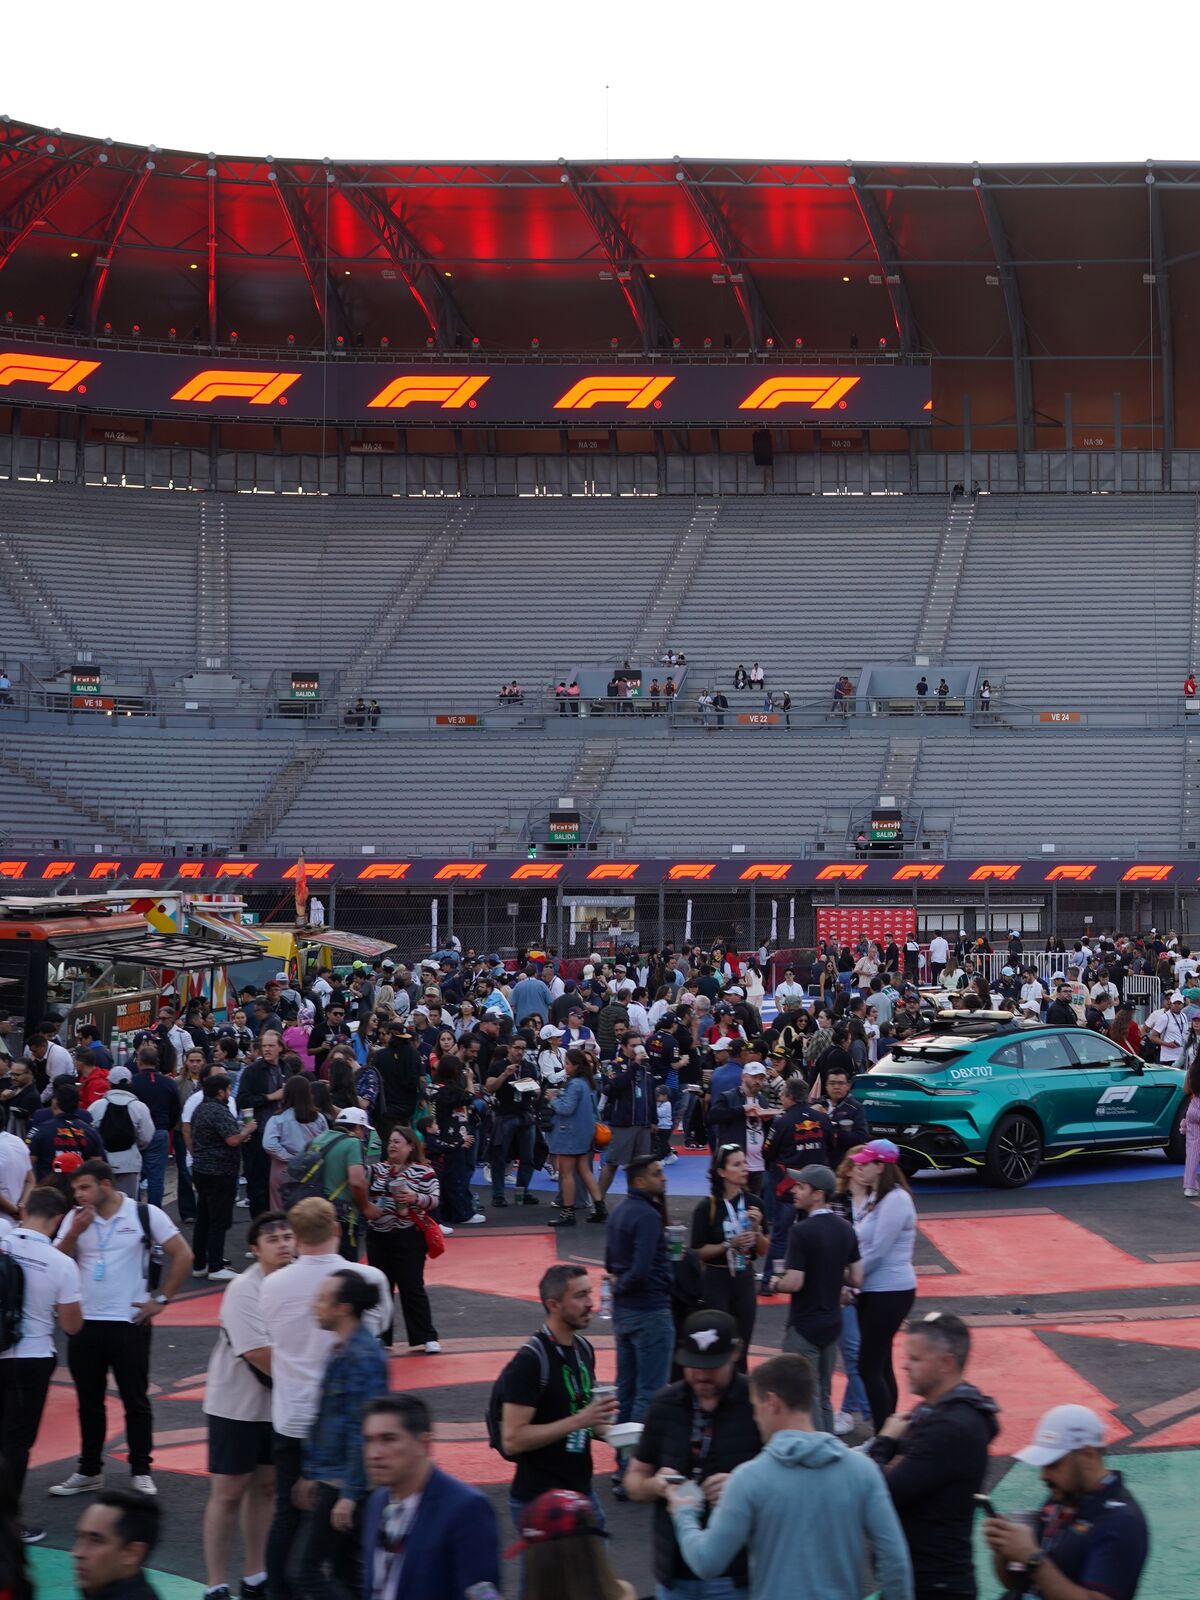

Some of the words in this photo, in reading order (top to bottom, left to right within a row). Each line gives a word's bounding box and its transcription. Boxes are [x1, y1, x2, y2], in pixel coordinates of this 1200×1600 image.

[172, 370, 301, 405] F1
[368, 375, 490, 409] F1
[555, 376, 675, 409] F1
[740, 376, 860, 409] F1
[76, 684, 98, 693] SALIDA
[295, 690, 316, 698] SALIDA
[84, 699, 95, 708] VE
[95, 699, 103, 708] 18
[447, 716, 458, 725] VE
[458, 716, 466, 725] 20
[749, 715, 759, 724] VE
[760, 715, 768, 724] 22
[1051, 713, 1060, 721] VE
[1061, 713, 1070, 721] 24
[552, 832, 578, 841] SALIDA
[950, 1065, 993, 1080] DBX707
[1097, 1085, 1139, 1104] F1
